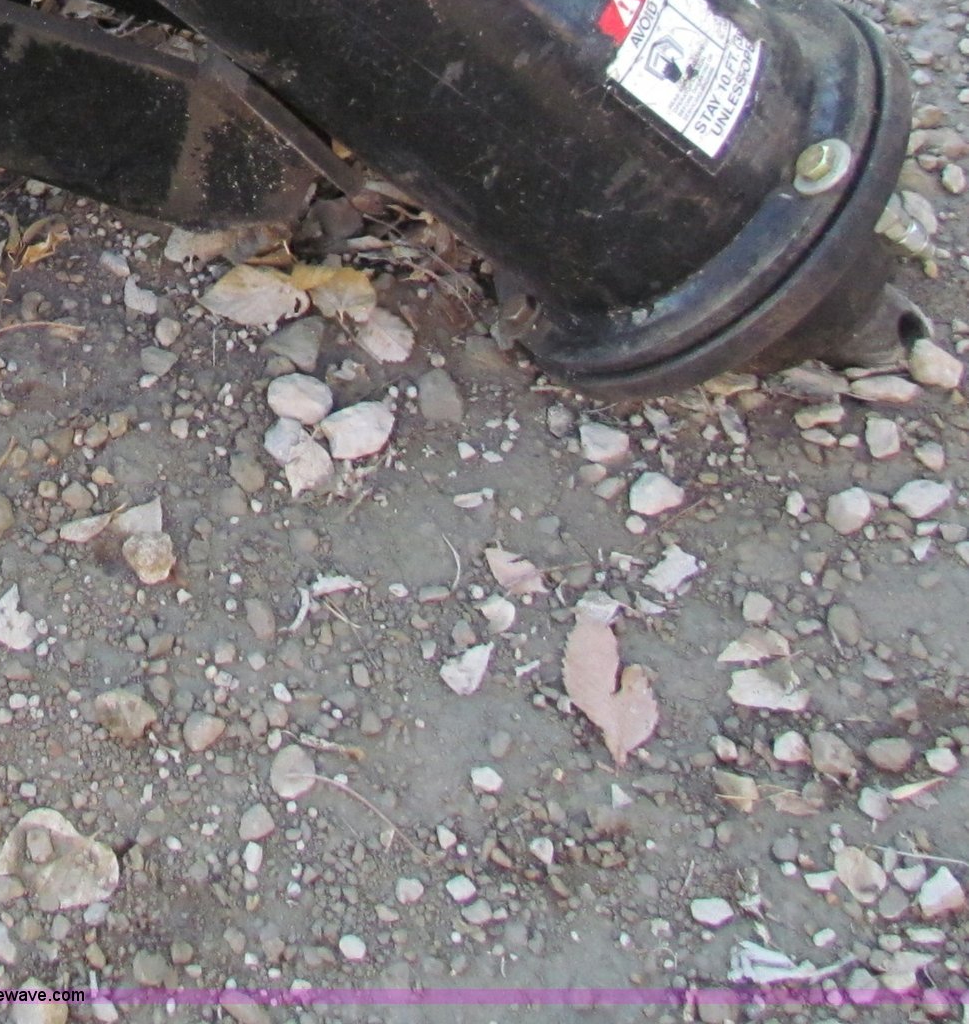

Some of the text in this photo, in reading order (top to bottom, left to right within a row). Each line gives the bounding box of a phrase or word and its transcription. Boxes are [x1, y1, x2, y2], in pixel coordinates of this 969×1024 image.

[632, 2, 657, 46] AVOID
[695, 97, 720, 133] STAY
[717, 74, 731, 91] 10
